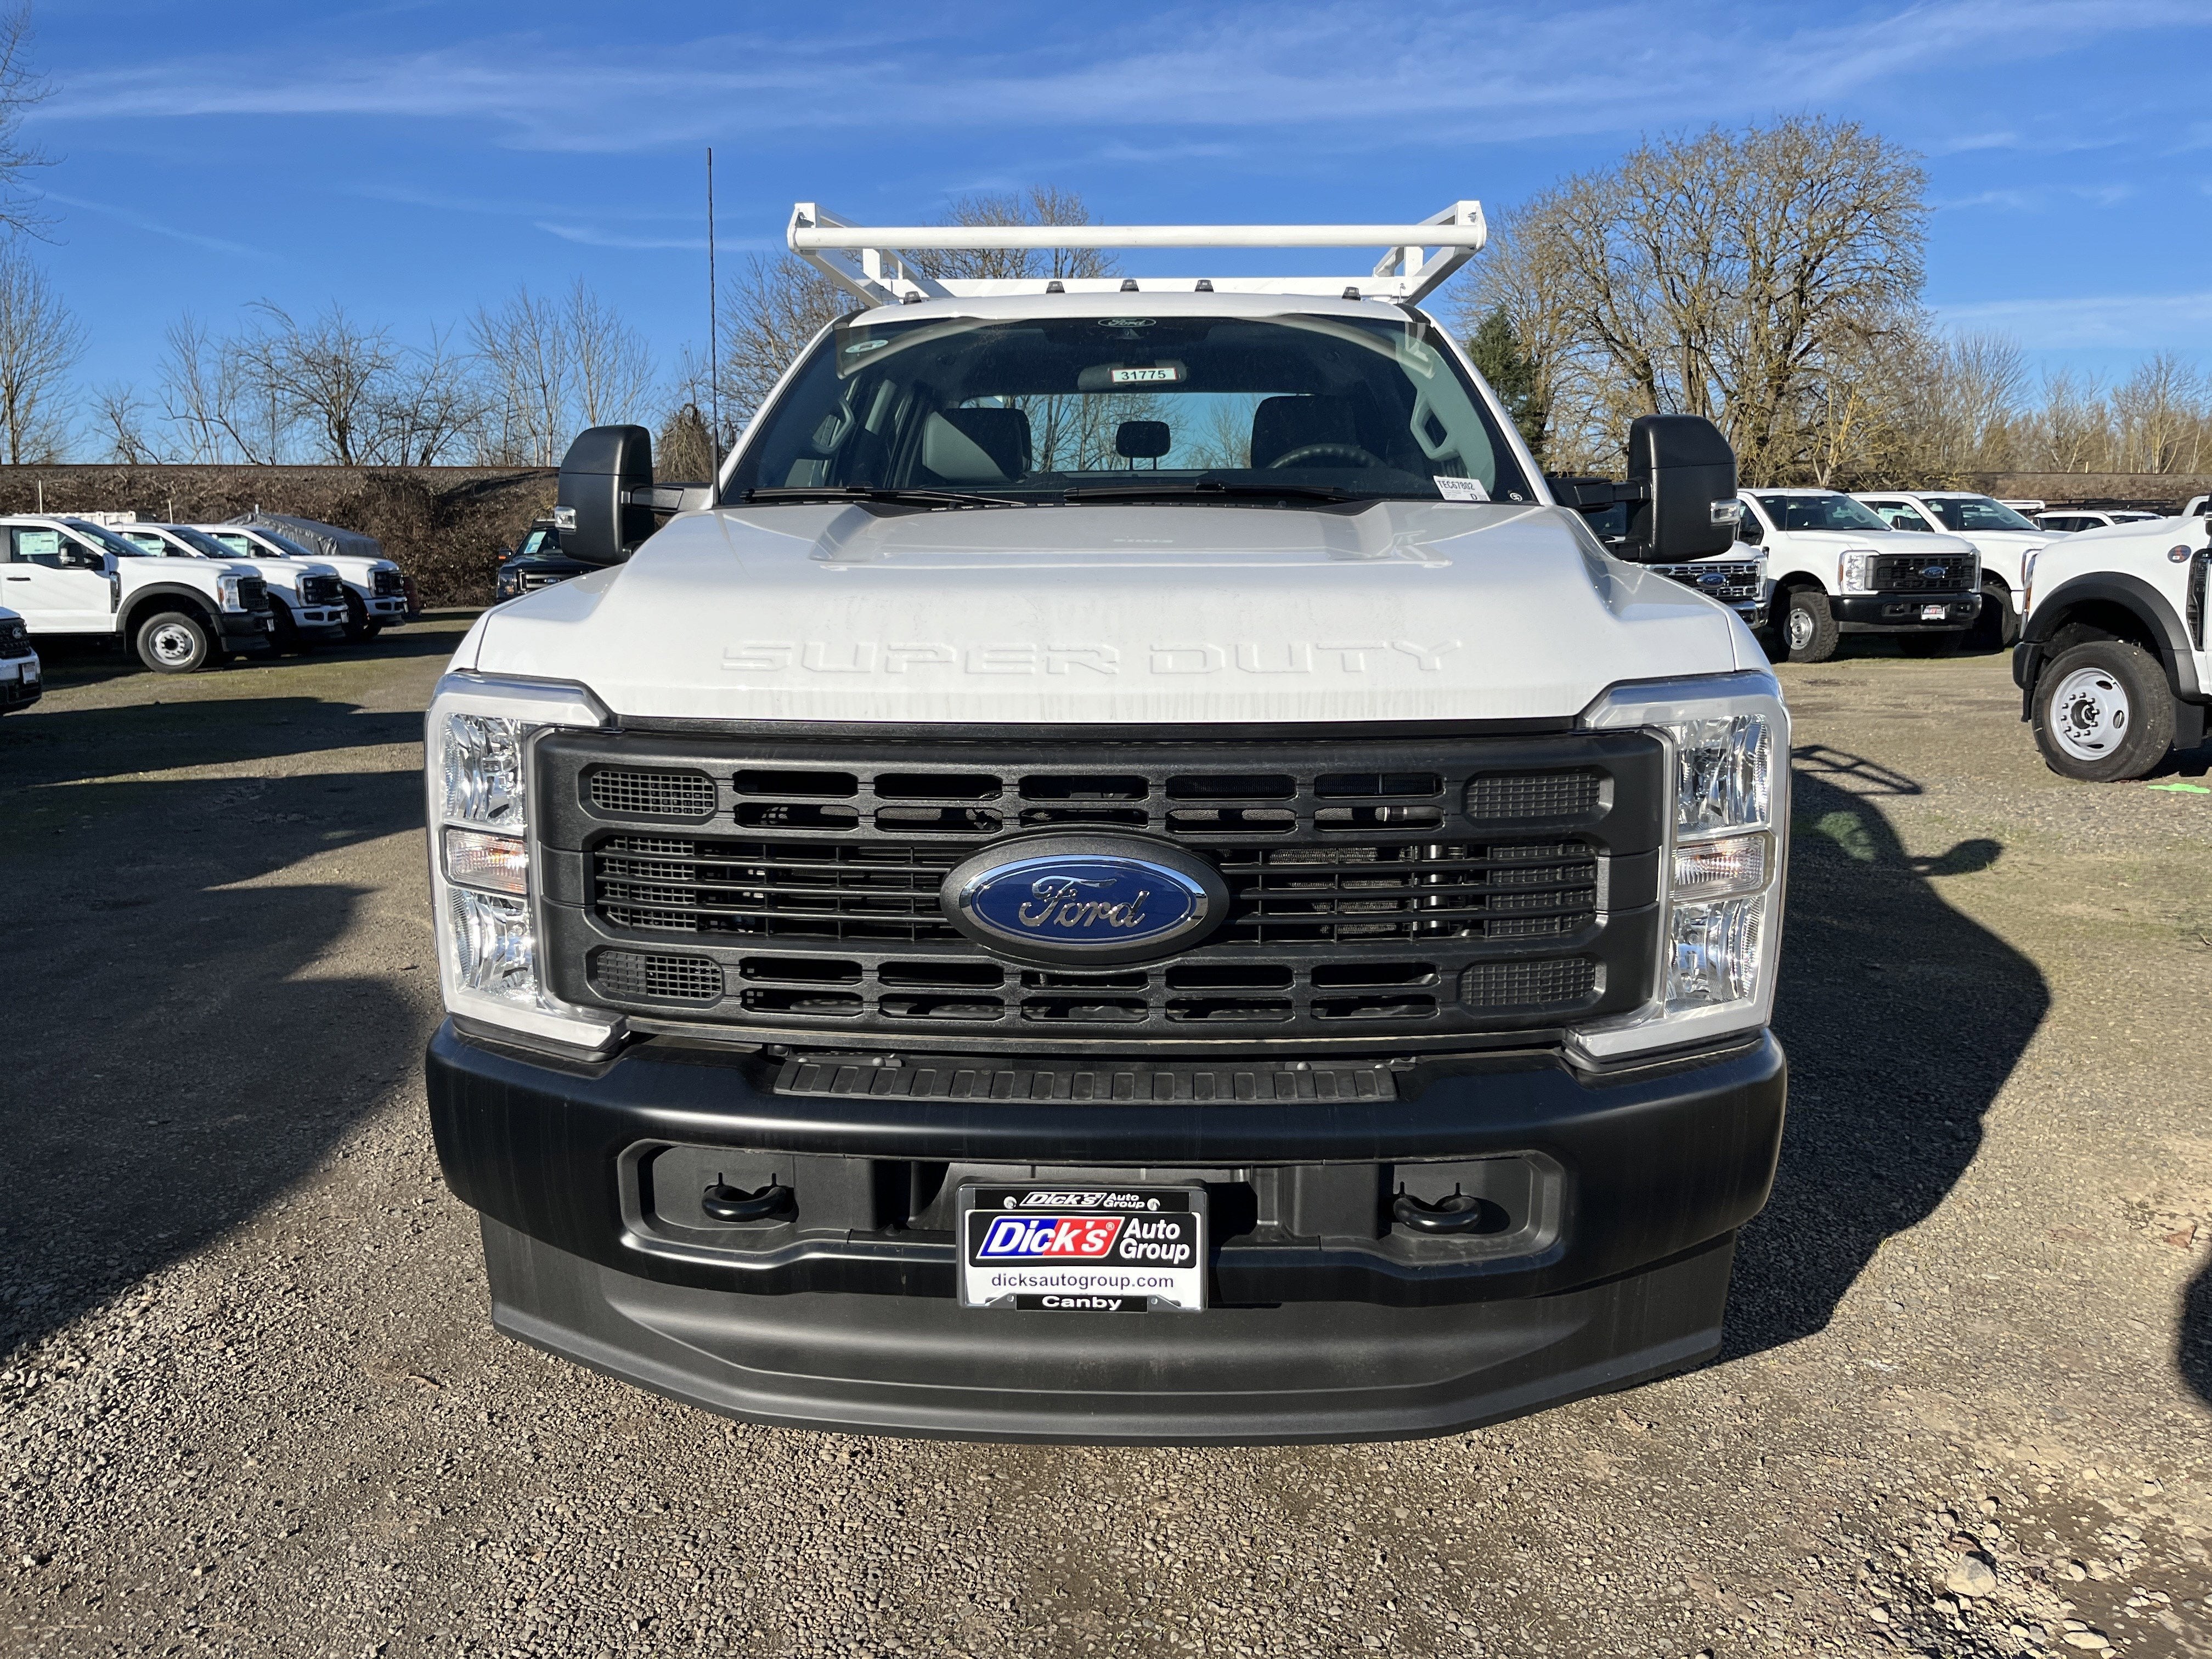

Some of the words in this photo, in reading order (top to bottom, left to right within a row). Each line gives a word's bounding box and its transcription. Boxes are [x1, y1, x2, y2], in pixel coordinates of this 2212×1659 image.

[1121, 370, 1166, 380] 31775
[1437, 481, 1475, 490] TEC67802
[721, 641, 1119, 674] SUPER
[1150, 640, 1462, 674] DUTY
[1018, 875, 1150, 928] Ford
[1026, 1193, 1097, 1205] Dick's
[1107, 1193, 1139, 1201] Auto
[1103, 1199, 1146, 1209] Group
[987, 1220, 1108, 1253] Dick's
[1123, 1218, 1181, 1239] Auto
[1119, 1239, 1190, 1265] Group
[991, 1273, 1174, 1290] dicksautogroup.com
[1041, 1295, 1122, 1311] Canby
